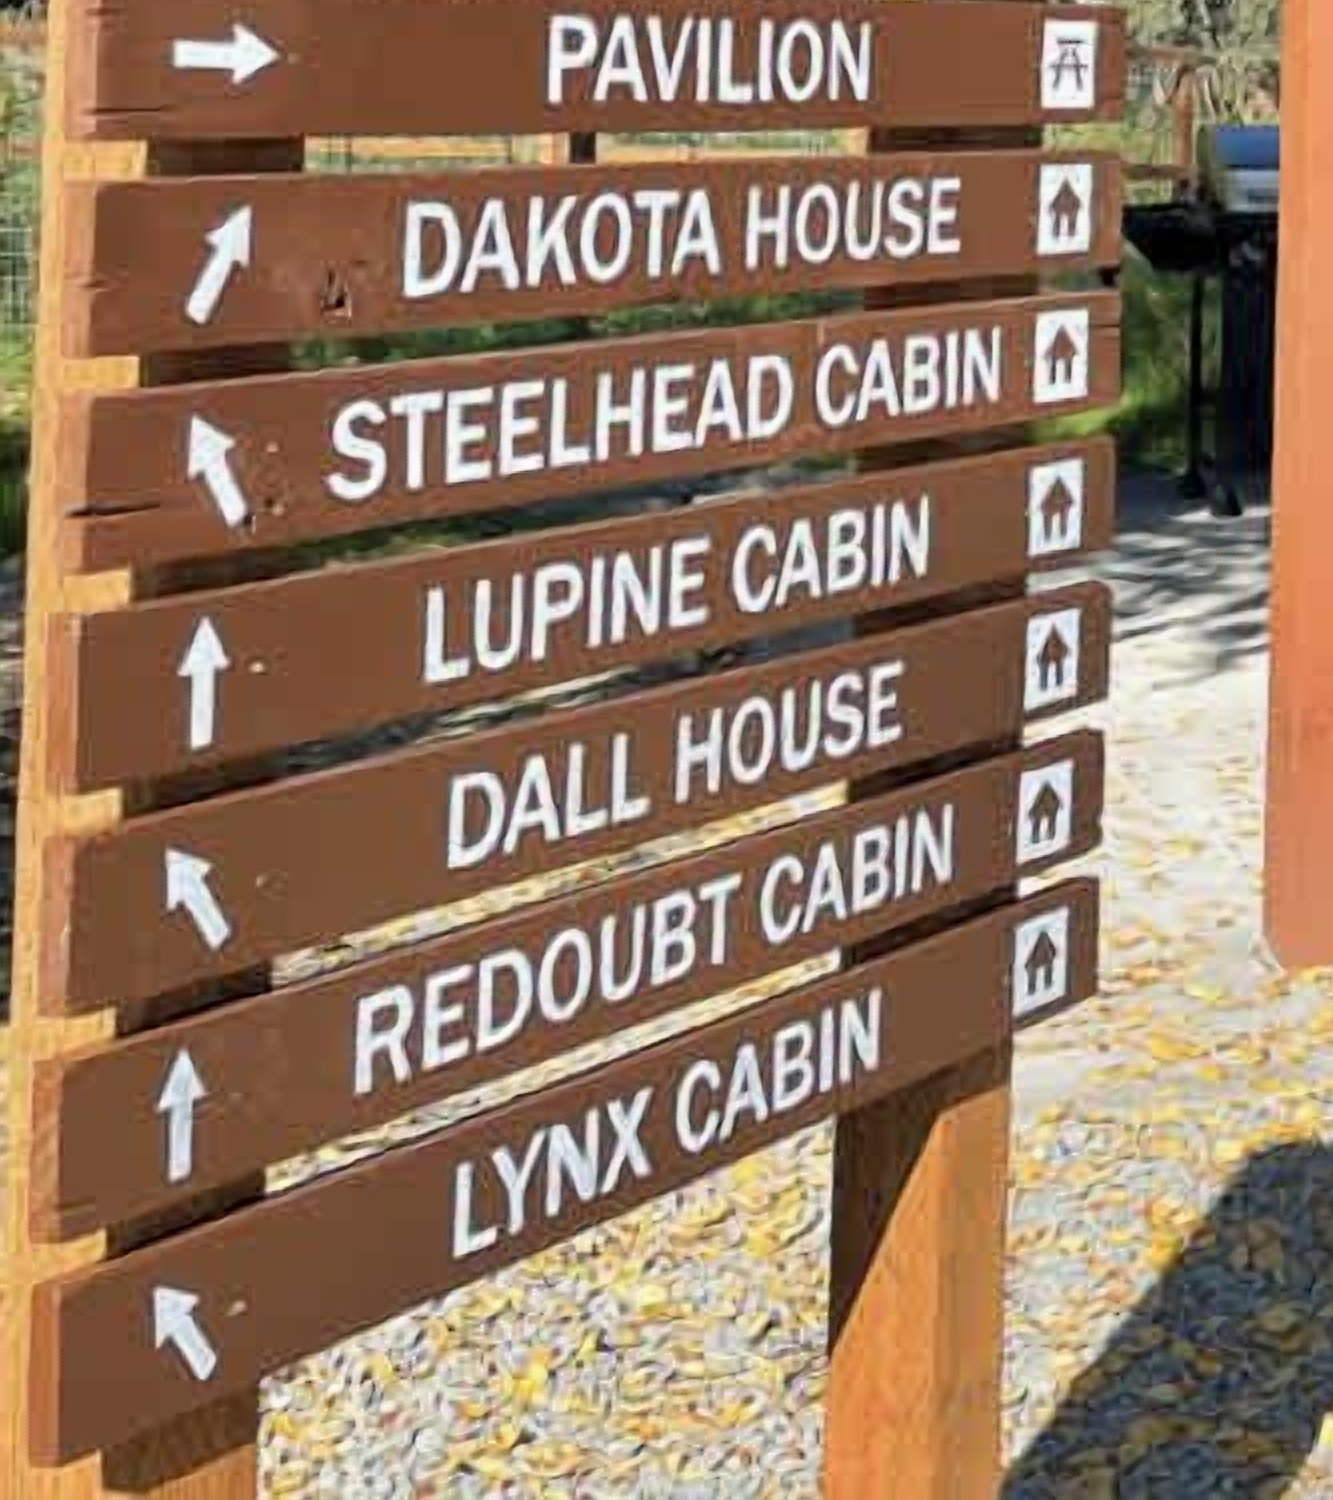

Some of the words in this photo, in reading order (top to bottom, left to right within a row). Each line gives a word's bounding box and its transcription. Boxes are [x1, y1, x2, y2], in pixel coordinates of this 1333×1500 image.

[546, 13, 872, 105] PAVILION
[402, 187, 722, 299] DAKOTA
[744, 176, 962, 271] HOUSE
[325, 353, 795, 506] STEELHEAD
[814, 325, 1002, 428] CABIN
[422, 534, 712, 685] LUPINE
[731, 494, 931, 614] CABIN
[446, 731, 651, 870] DALL
[674, 659, 905, 804] HOUSE
[353, 872, 743, 1095] REDOUBT
[759, 802, 955, 945] CABIN
[452, 1086, 653, 1259] LYNX
[674, 987, 883, 1154] CABIN
